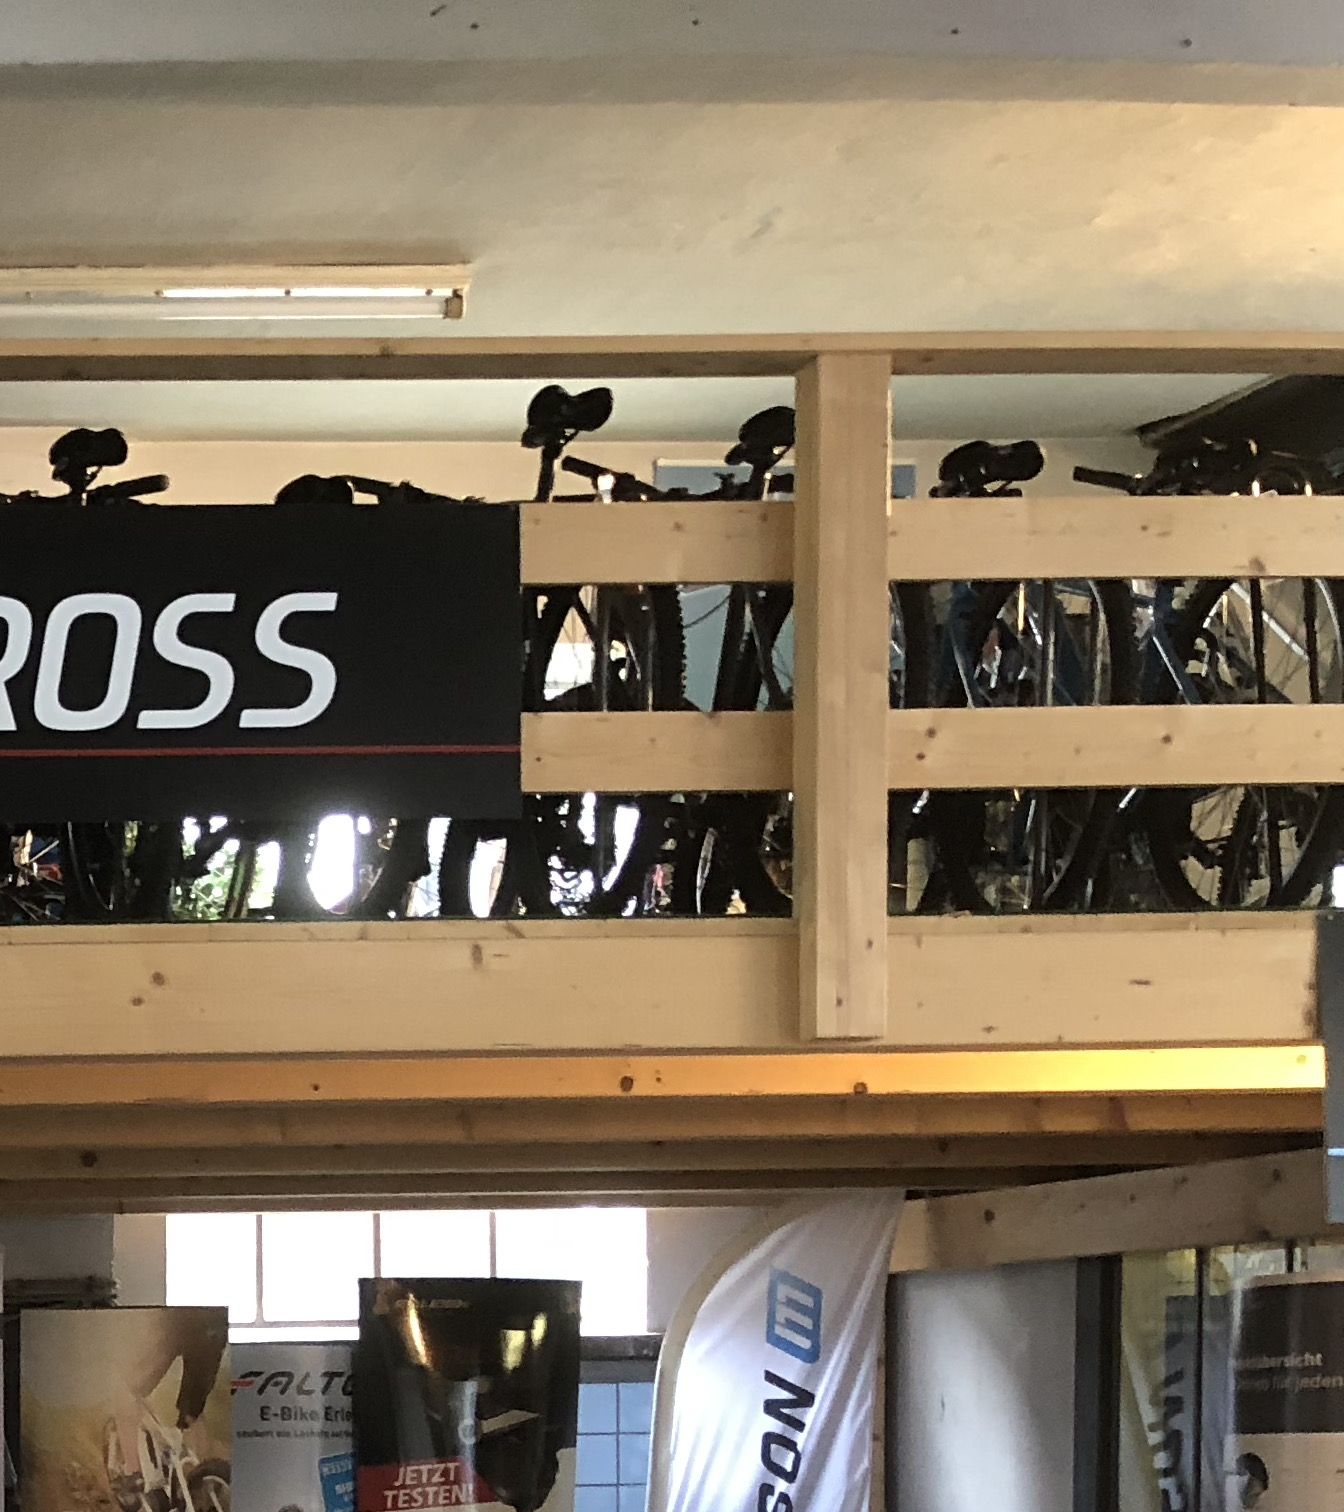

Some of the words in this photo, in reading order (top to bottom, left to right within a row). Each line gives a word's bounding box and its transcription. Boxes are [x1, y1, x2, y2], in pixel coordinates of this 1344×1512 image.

[260, 1405, 319, 1422] E-Bike
[324, 1405, 352, 1422] Erle
[394, 1462, 460, 1486] JETZT
[383, 1484, 474, 1509] TESTEN!
